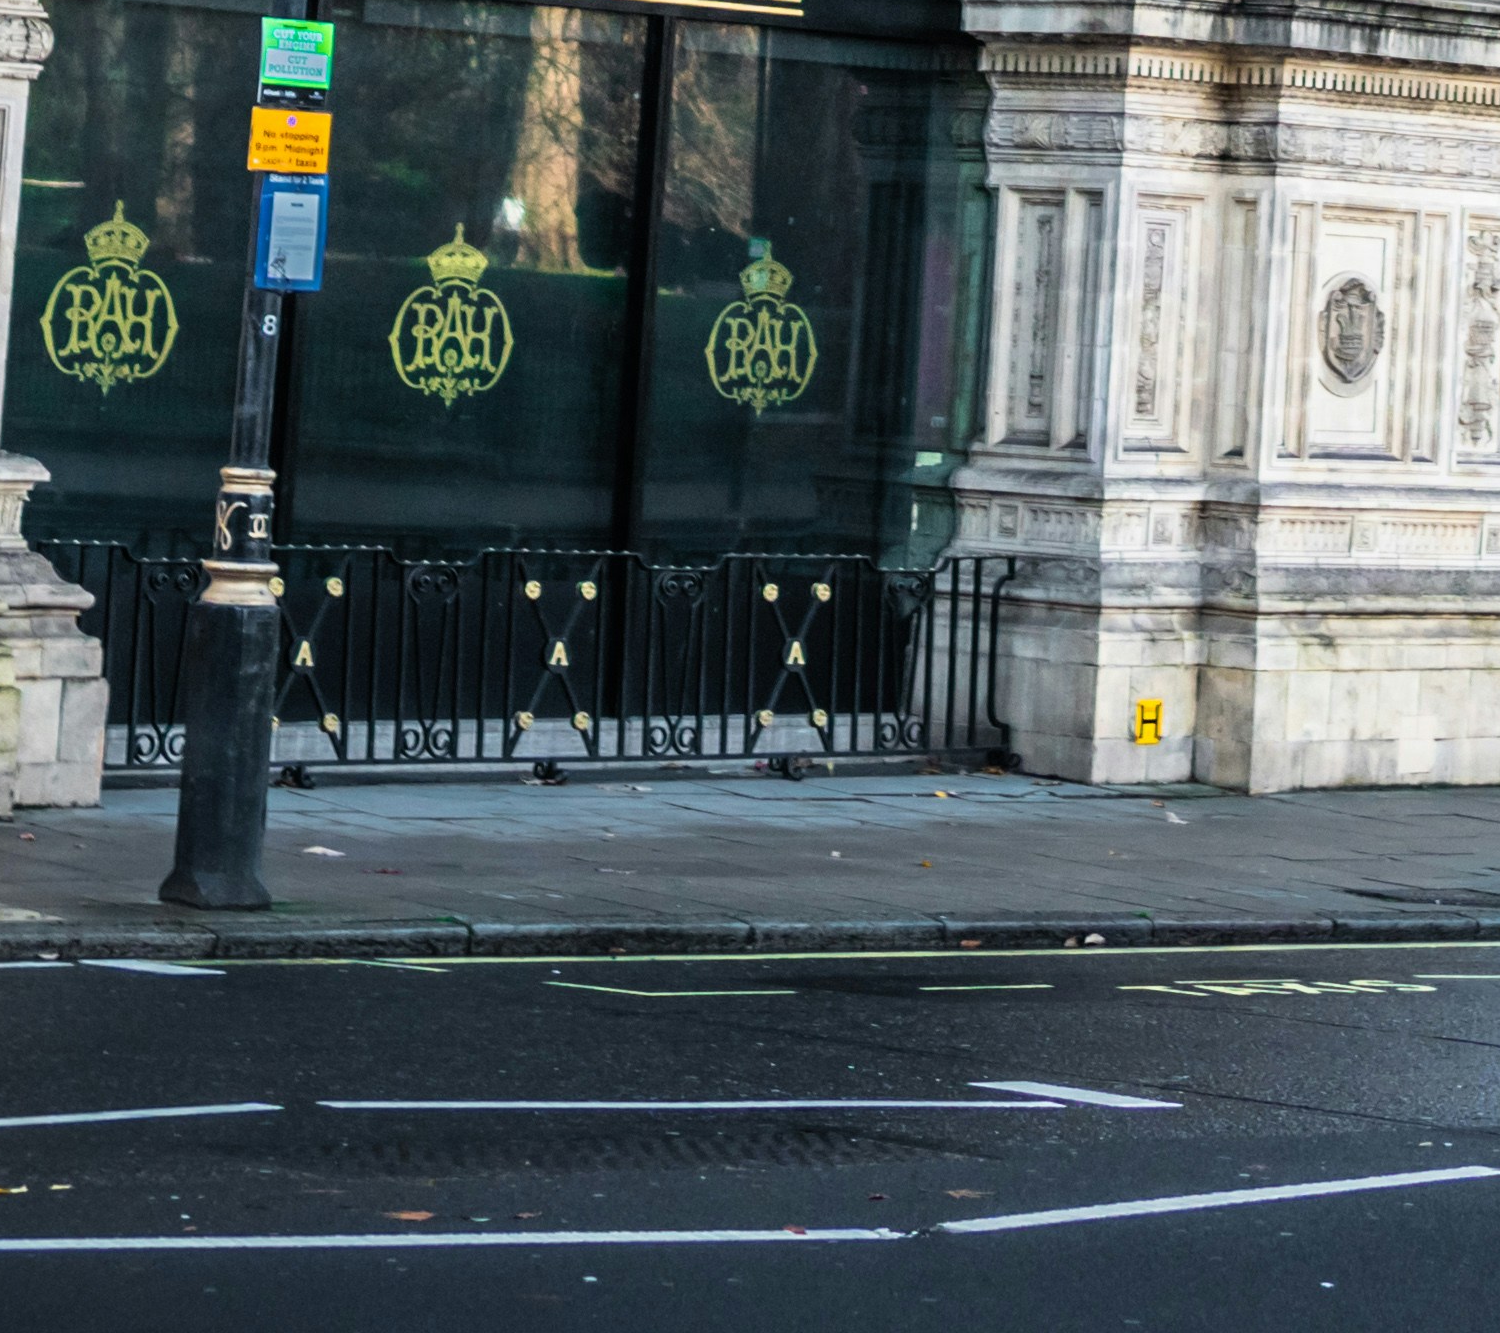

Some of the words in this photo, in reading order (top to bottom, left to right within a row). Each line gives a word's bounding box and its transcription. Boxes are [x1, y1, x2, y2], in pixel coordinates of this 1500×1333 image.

[273, 29, 295, 39] CUT
[297, 31, 323, 42] YOUR
[288, 55, 308, 65] CUT
[268, 64, 323, 77] POLLUTION
[263, 130, 276, 138] No
[280, 131, 320, 143] stopping
[284, 144, 324, 156] Midnight
[296, 158, 317, 167] taxis
[263, 314, 277, 336] 8
[294, 640, 315, 667] A
[549, 641, 569, 666] A
[786, 641, 806, 666] A
[1138, 704, 1162, 740] H
[1116, 978, 1438, 997] TAXIS
